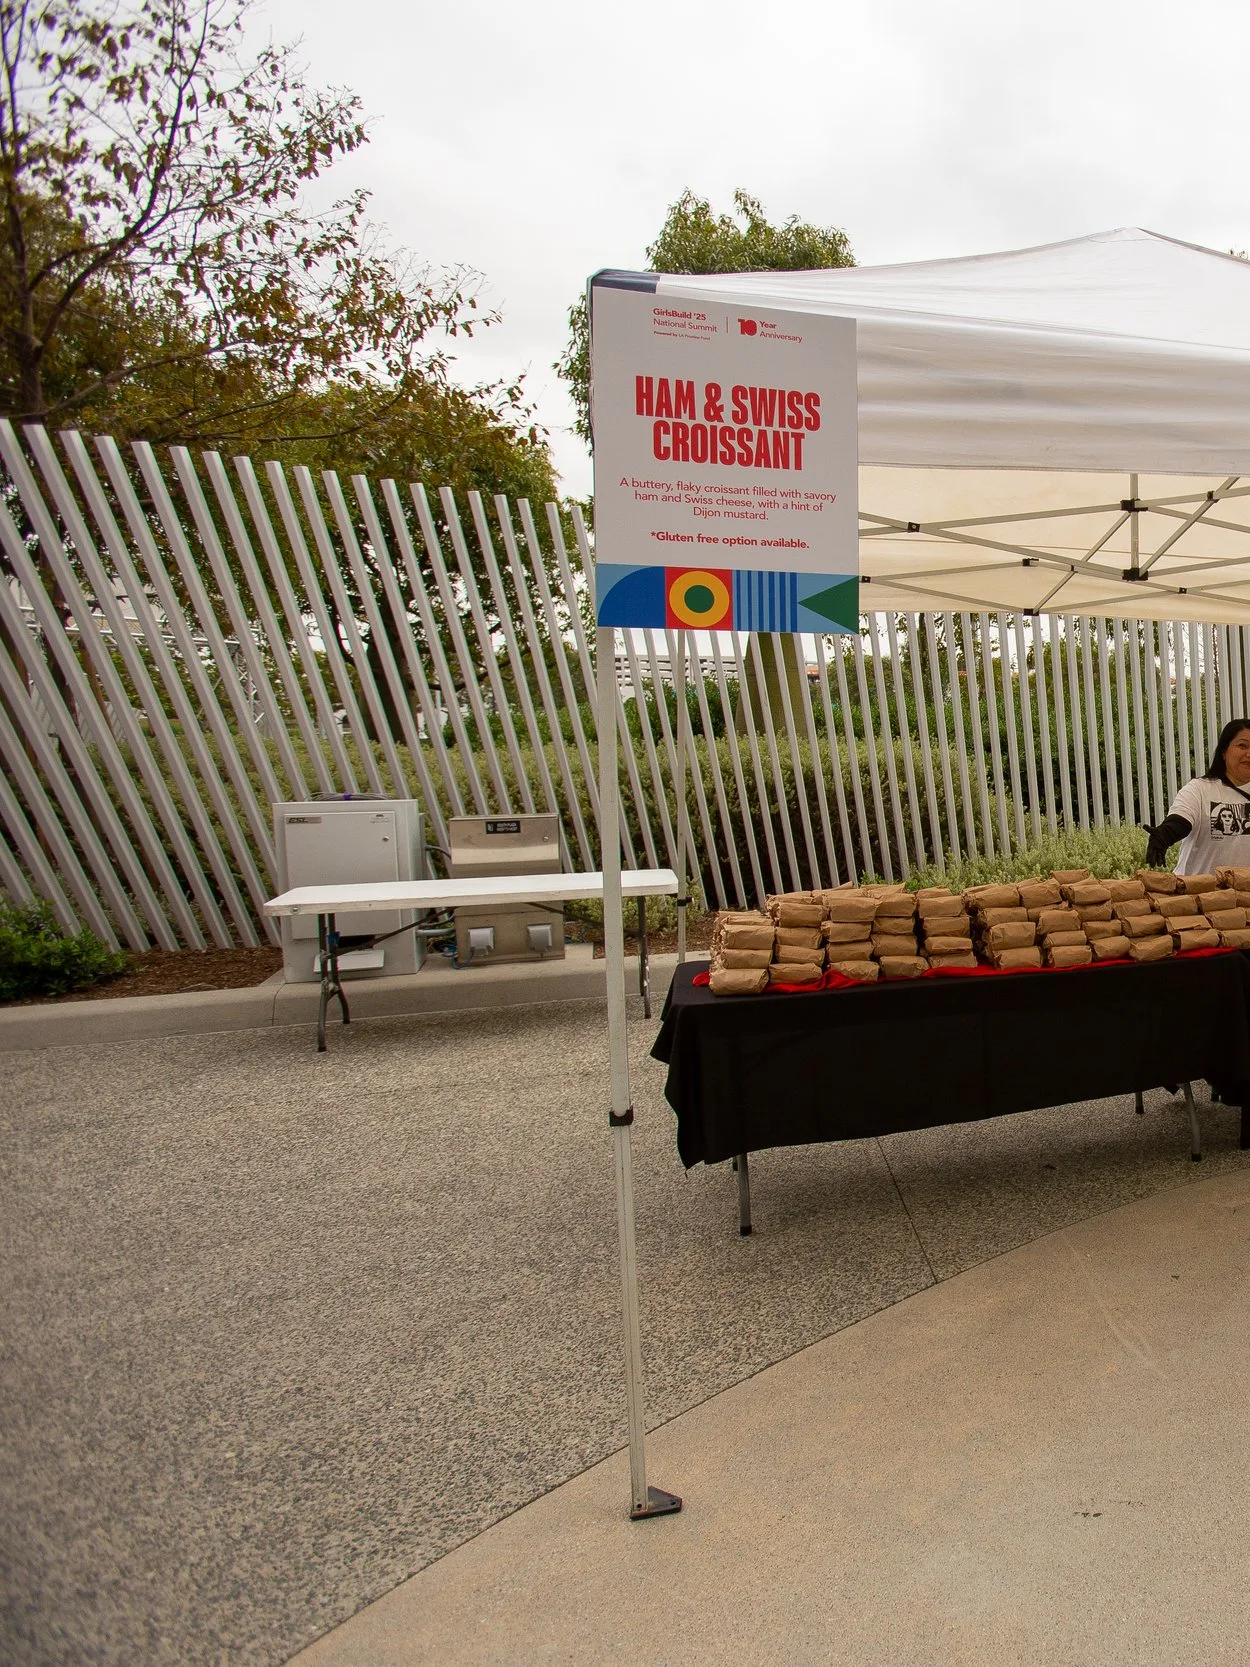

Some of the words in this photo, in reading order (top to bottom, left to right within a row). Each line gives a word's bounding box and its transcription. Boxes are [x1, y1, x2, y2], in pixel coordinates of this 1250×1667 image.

[653, 308, 691, 319] GirlsBuild
[654, 319, 686, 328] National
[688, 322, 717, 332] Summit
[738, 319, 757, 336] 10
[760, 321, 776, 329] Year
[760, 331, 802, 343] Anniversary
[636, 375, 696, 421] HAM
[704, 382, 724, 423] &
[732, 385, 821, 432] SWISS
[653, 420, 805, 470] CROISSANT
[620, 477, 629, 487] A
[632, 478, 673, 492] buttery,
[677, 481, 701, 494] flaky
[704, 485, 749, 496] croissant
[752, 486, 776, 497] filled
[780, 488, 801, 499] with
[804, 492, 836, 503] savory
[635, 491, 658, 501] ham
[662, 492, 681, 502] and
[685, 494, 713, 505] Swiss
[716, 496, 755, 509] cheese,
[758, 499, 779, 509] with
[782, 502, 788, 510] a
[791, 500, 809, 511] hint
[813, 502, 823, 512] of
[693, 507, 720, 520] Dijon
[724, 509, 768, 520] mustard.
[697, 533, 718, 544] free
[723, 535, 757, 548] option
[760, 537, 809, 549] available.
